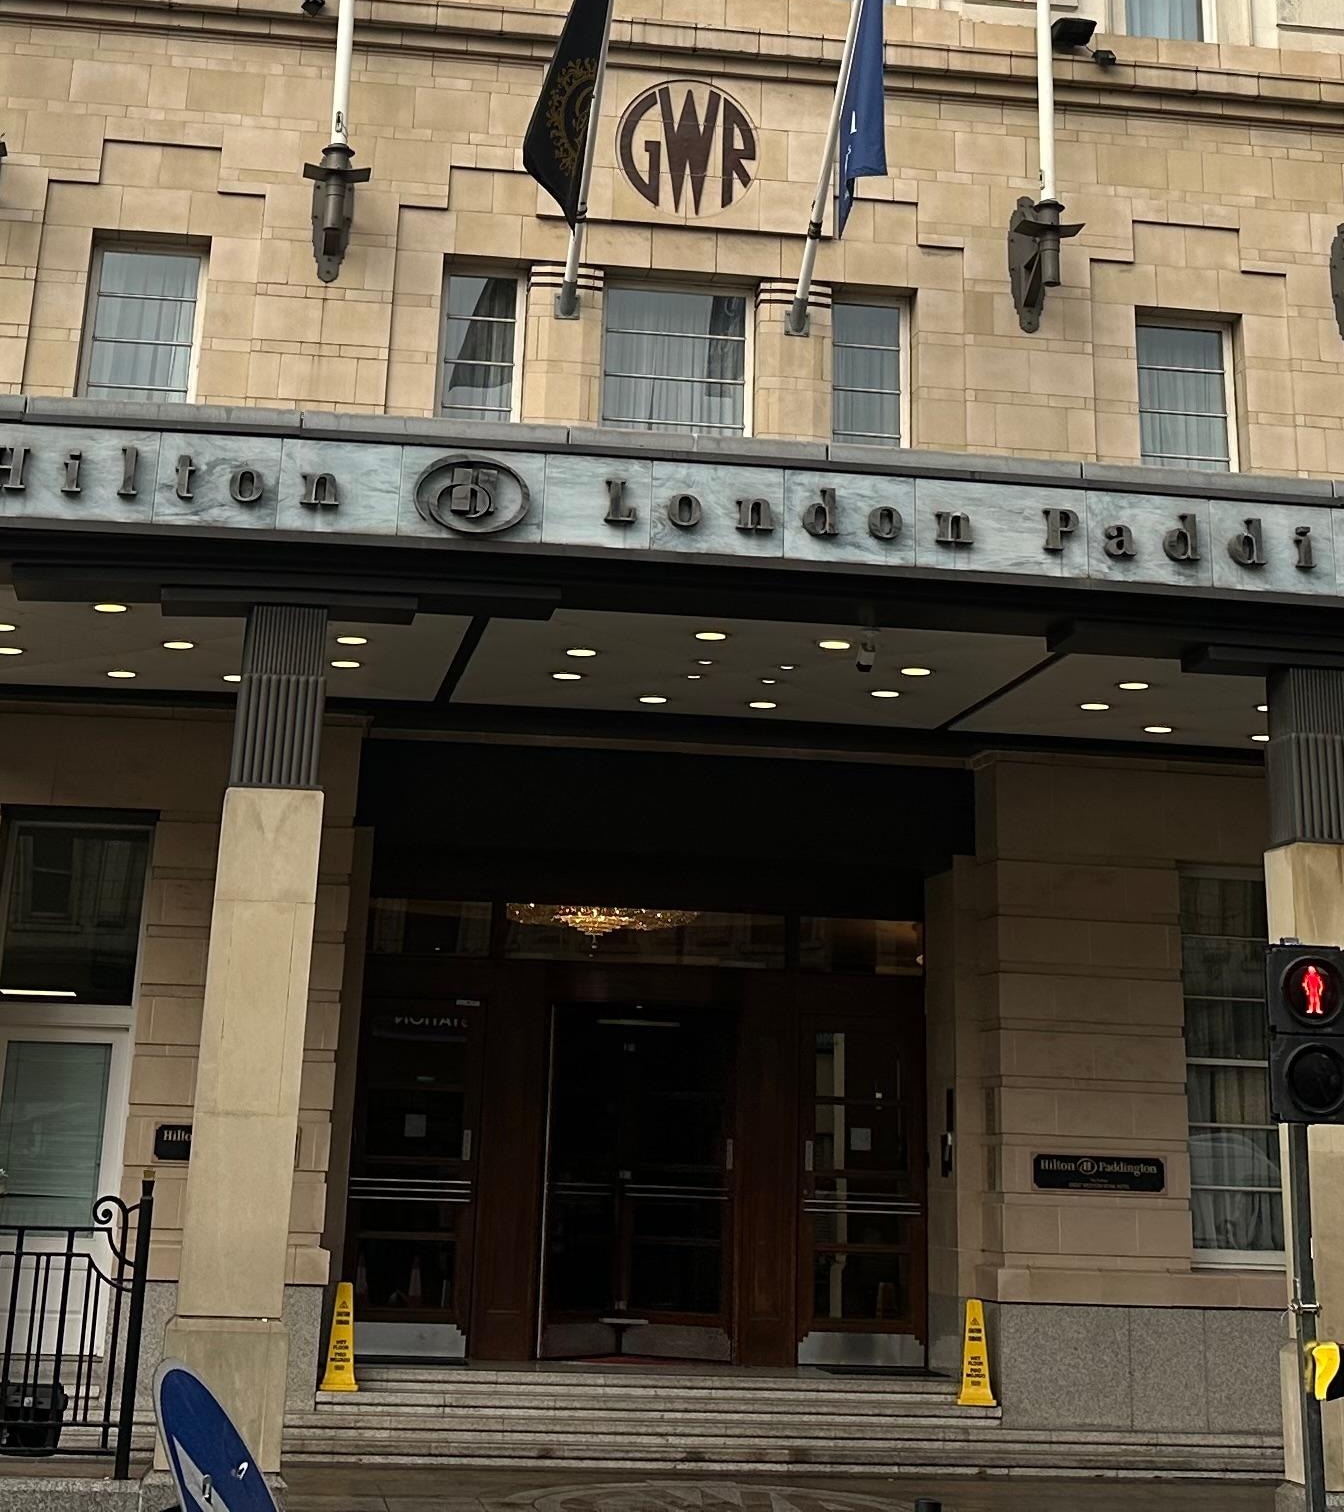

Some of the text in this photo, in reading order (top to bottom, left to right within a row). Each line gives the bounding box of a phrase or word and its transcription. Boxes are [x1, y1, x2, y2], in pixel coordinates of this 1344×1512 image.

[620, 86, 756, 216] GWR
[604, 478, 973, 546] London
[1040, 1159, 1075, 1171] Hilton
[1099, 1162, 1157, 1177] Paddington
